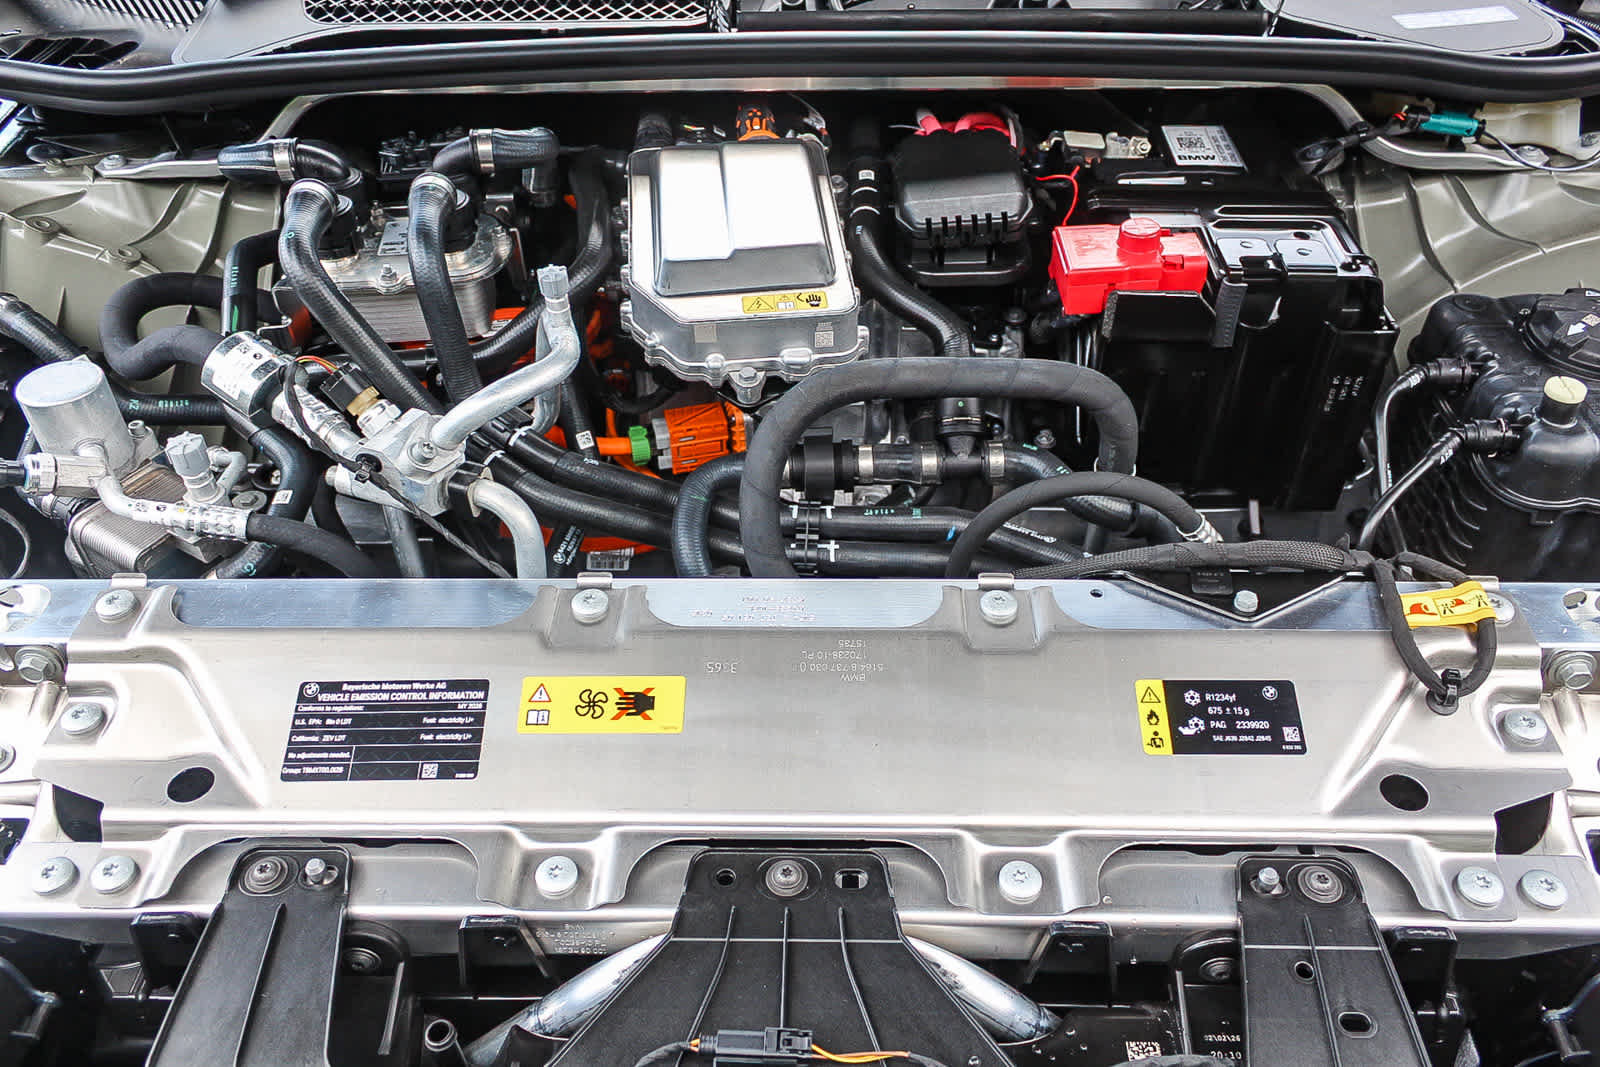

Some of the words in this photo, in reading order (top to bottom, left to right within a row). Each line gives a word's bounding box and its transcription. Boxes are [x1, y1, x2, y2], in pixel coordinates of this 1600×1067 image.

[342, 682, 381, 691] Bayerische
[381, 682, 411, 690] Motoren
[412, 681, 435, 689] Werke
[435, 681, 447, 689] AG
[318, 692, 350, 701] VEHICLE
[350, 692, 390, 701] EMISSION
[390, 691, 428, 701] CONTROL
[428, 691, 485, 700] INFORMATION
[1205, 692, 1237, 703] R1234yf
[1207, 706, 1223, 715] 675
[1233, 706, 1243, 715] 15
[1209, 720, 1227, 729] PAG
[1235, 720, 1270, 729] 2339920
